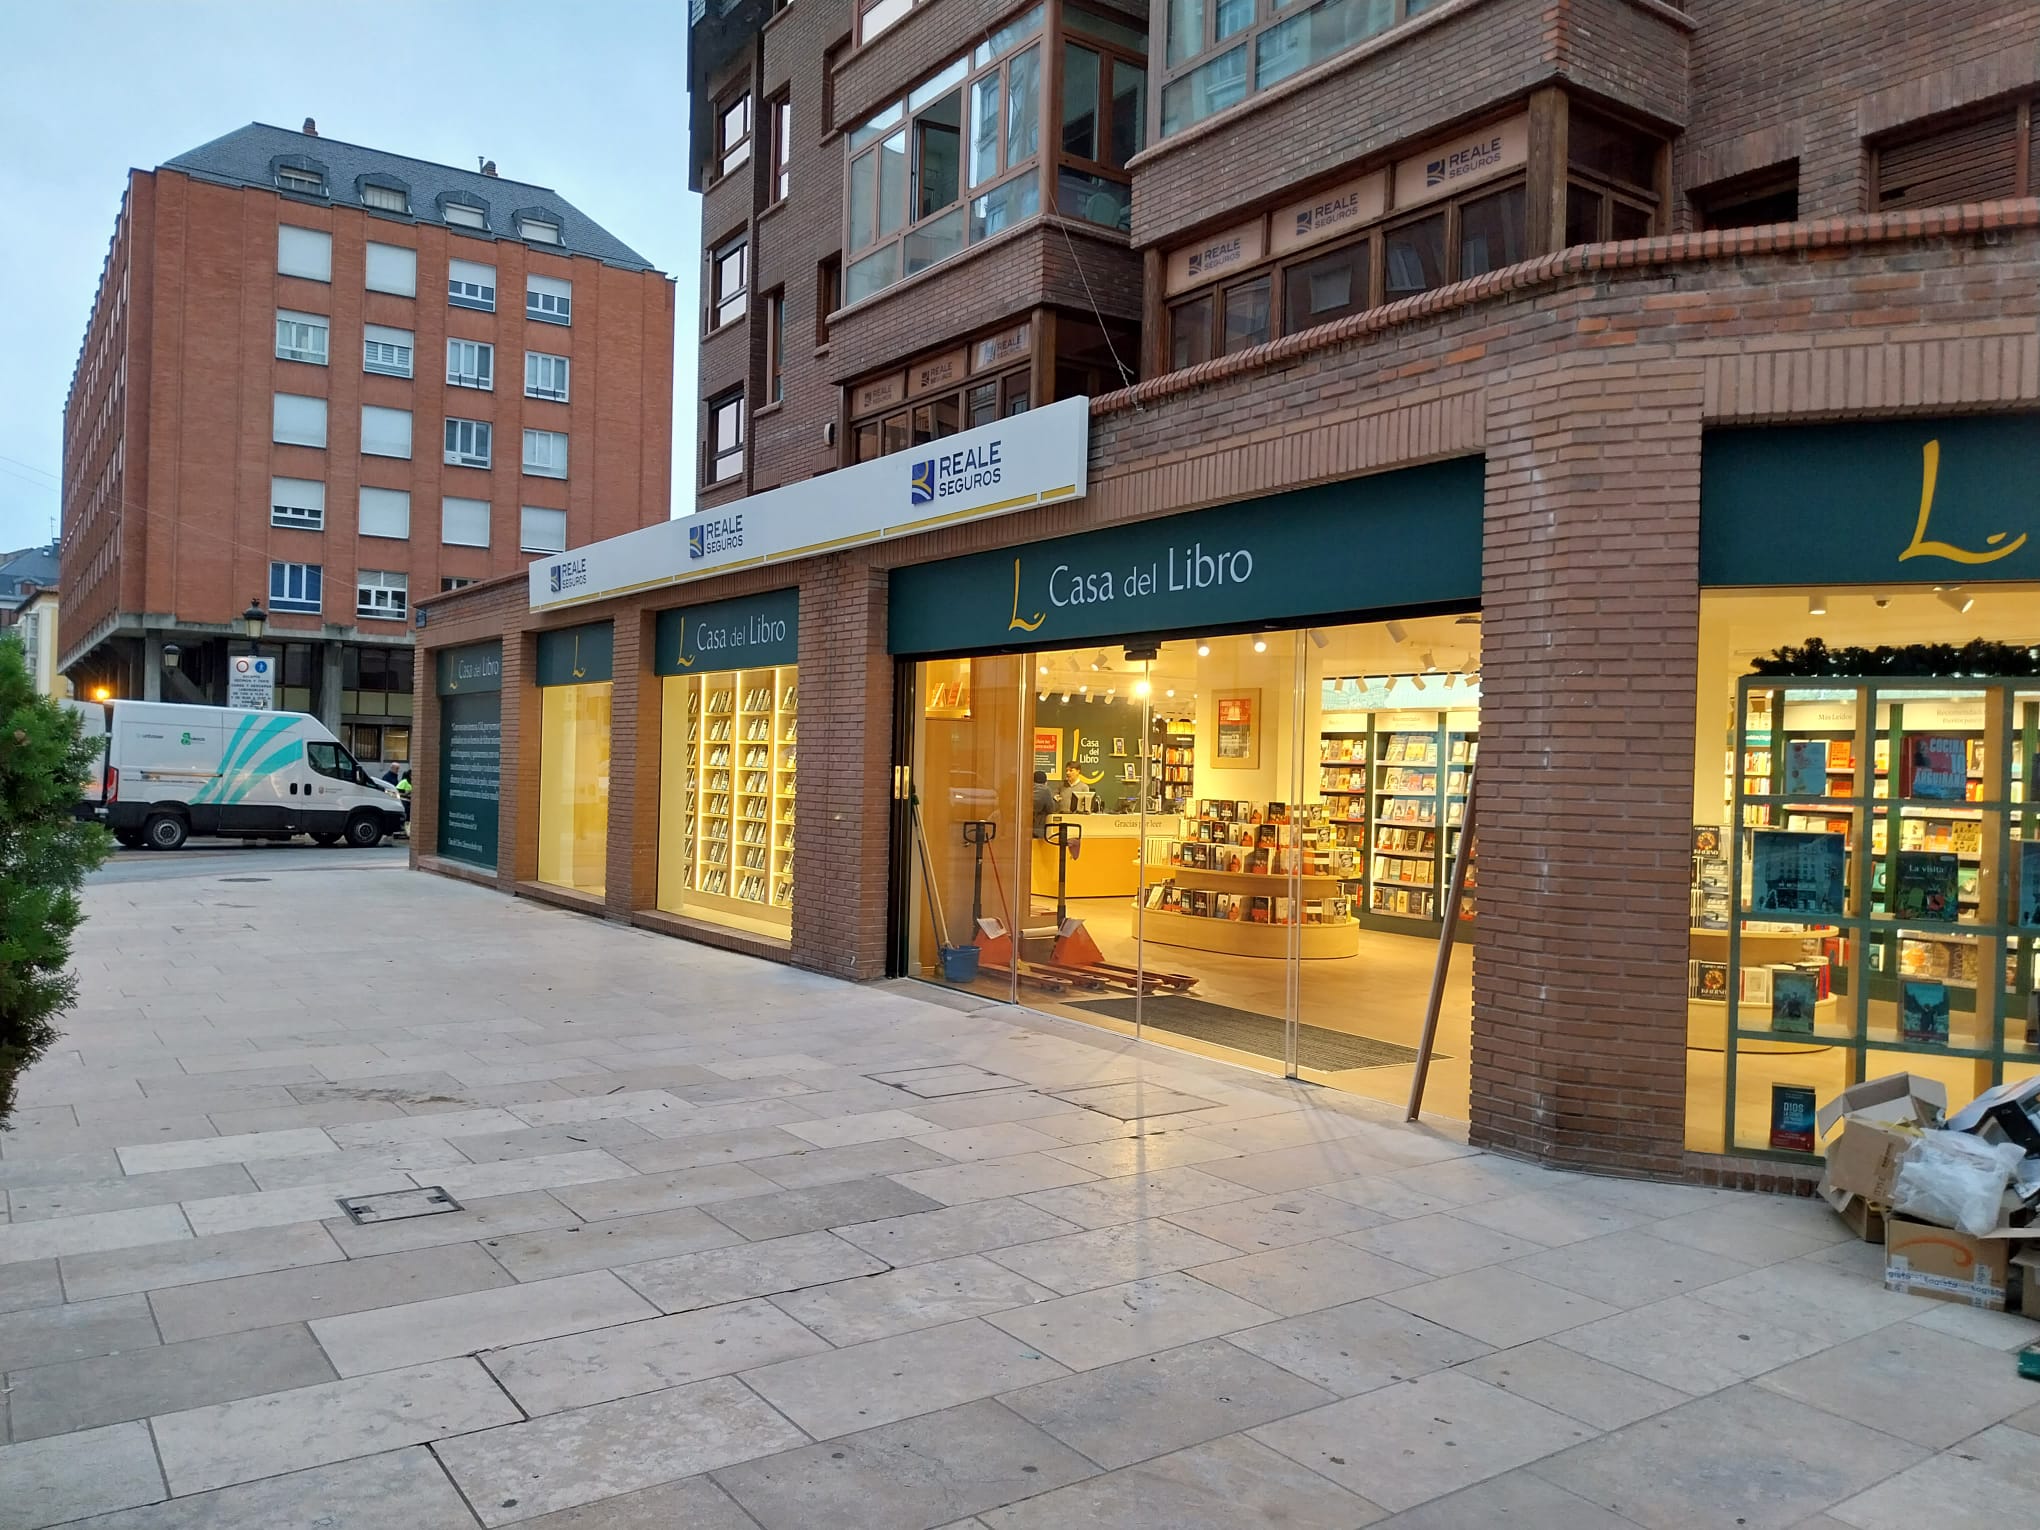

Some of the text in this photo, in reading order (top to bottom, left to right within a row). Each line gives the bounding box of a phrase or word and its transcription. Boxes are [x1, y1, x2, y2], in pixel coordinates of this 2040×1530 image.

[1449, 137, 1502, 168] REALE
[1449, 152, 1502, 179] SEGUROS
[1314, 193, 1358, 219] REALE
[1314, 206, 1358, 229] SEGUROS
[1204, 238, 1241, 261] REALE
[1204, 251, 1241, 271] SEGUROS
[997, 335, 1023, 350] REALE
[929, 362, 953, 378] REALE
[939, 440, 1002, 479] REALE
[939, 467, 1002, 498] SEGUROS
[706, 514, 743, 540] REALE
[706, 535, 744, 554] SEGUROS
[562, 558, 587, 577] REALE
[1049, 565, 1115, 607] Casa
[1123, 562, 1156, 598] del
[1168, 543, 1253, 592] Libro
[562, 574, 587, 589] SEGUROS
[697, 622, 726, 652] Casa
[730, 625, 746, 648] del
[750, 614, 786, 644] Libro
[459, 660, 473, 679] Casa
[482, 655, 499, 677] Libro
[1080, 737, 1099, 748] Casa
[1089, 748, 1100, 756] del
[1079, 754, 1099, 764] Libro
[1114, 819, 1138, 829] Gracias
[1150, 819, 1162, 828] leer
[1909, 863, 1945, 874] La visita
[1783, 1102, 1804, 1113] DIOS
